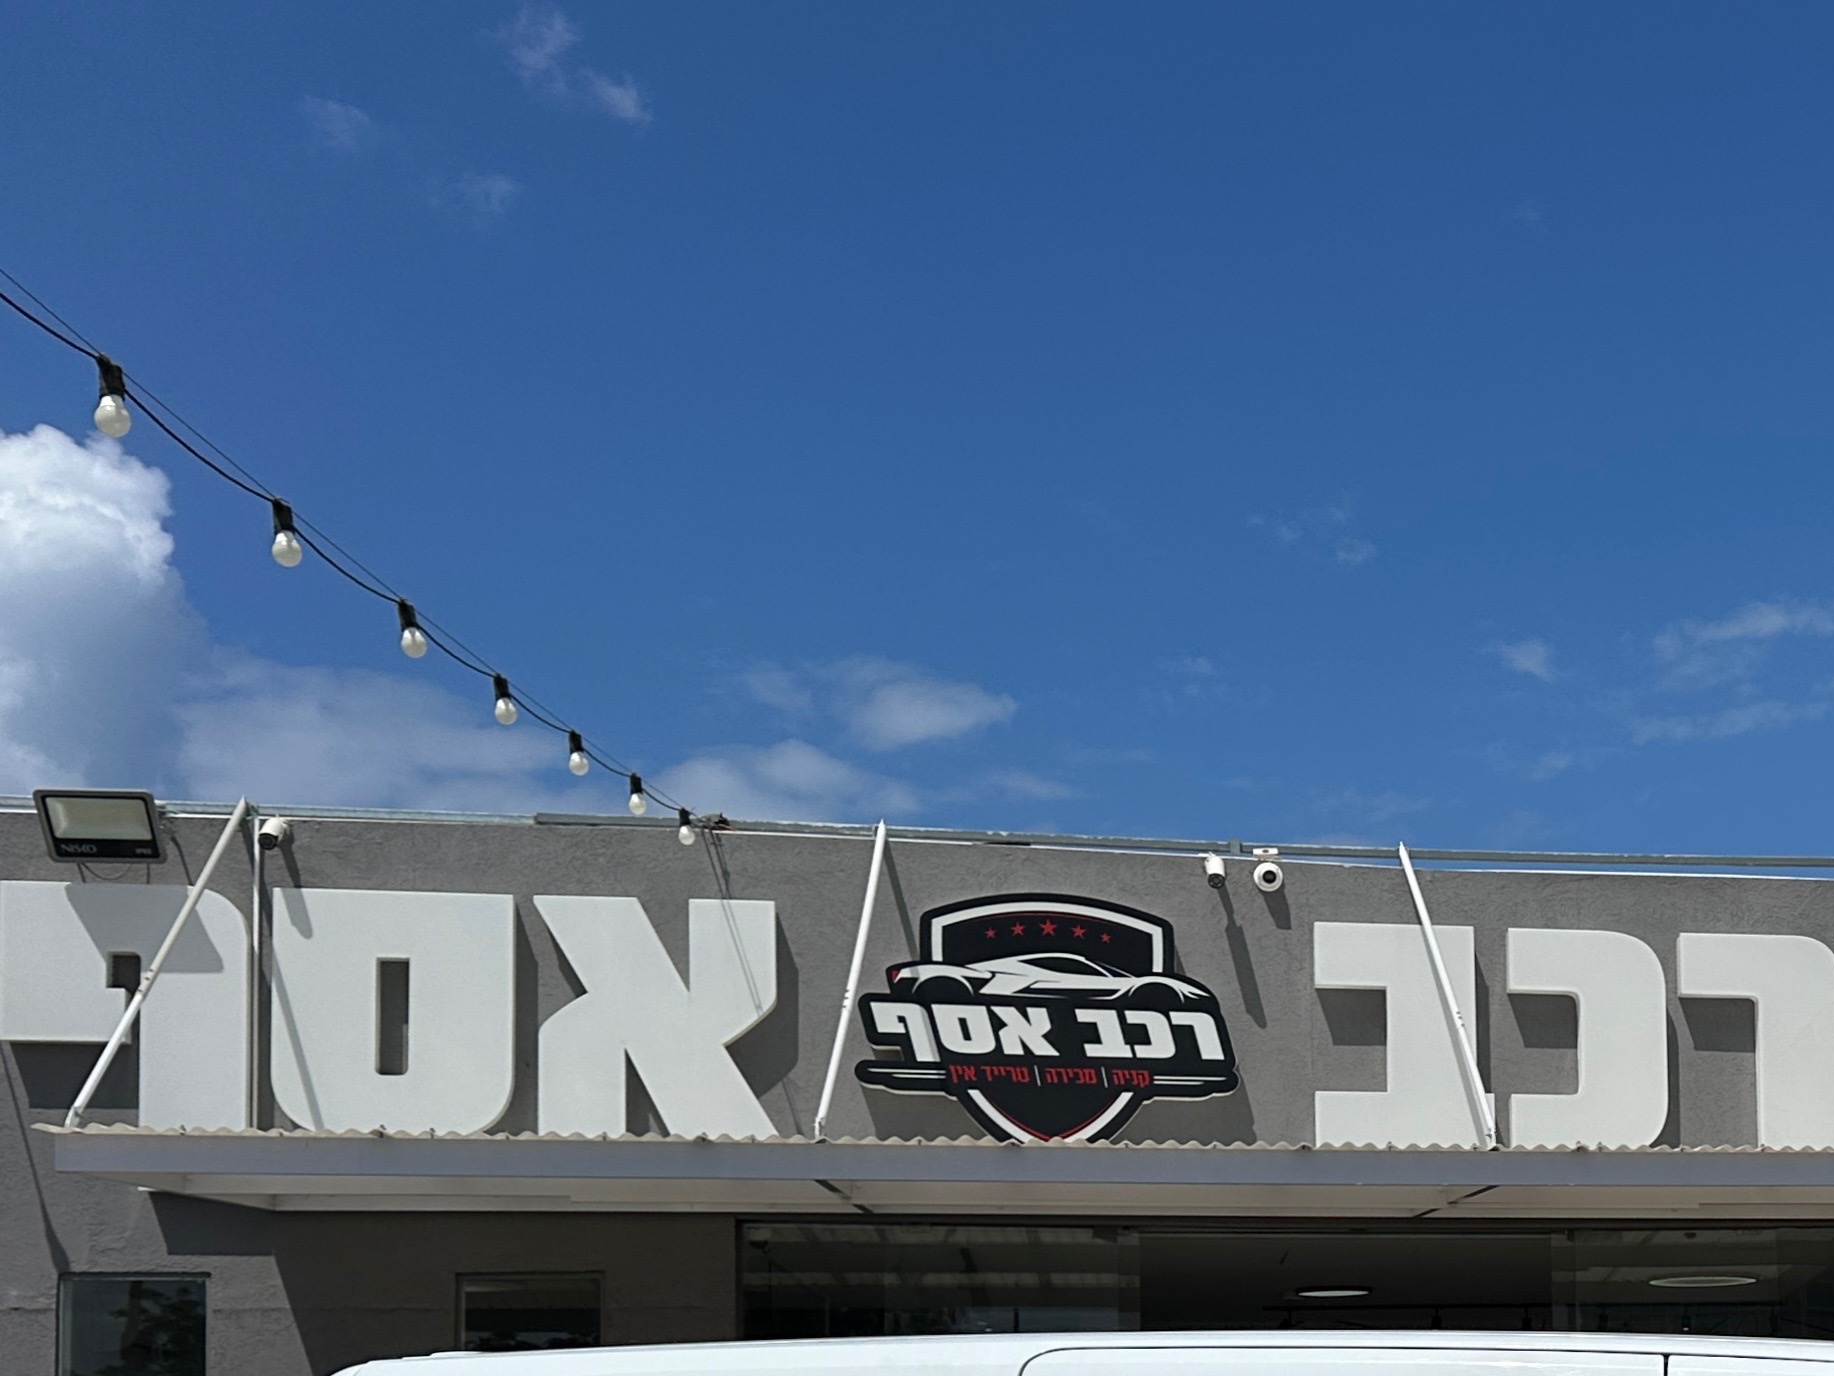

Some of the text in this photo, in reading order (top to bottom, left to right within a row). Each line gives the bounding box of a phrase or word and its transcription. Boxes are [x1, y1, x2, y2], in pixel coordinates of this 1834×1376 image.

[0, 880, 778, 1138] אסף
[869, 1000, 1226, 1063] רכב אסף
[949, 1063, 1150, 1088] קניה מכירה טרייד אין
